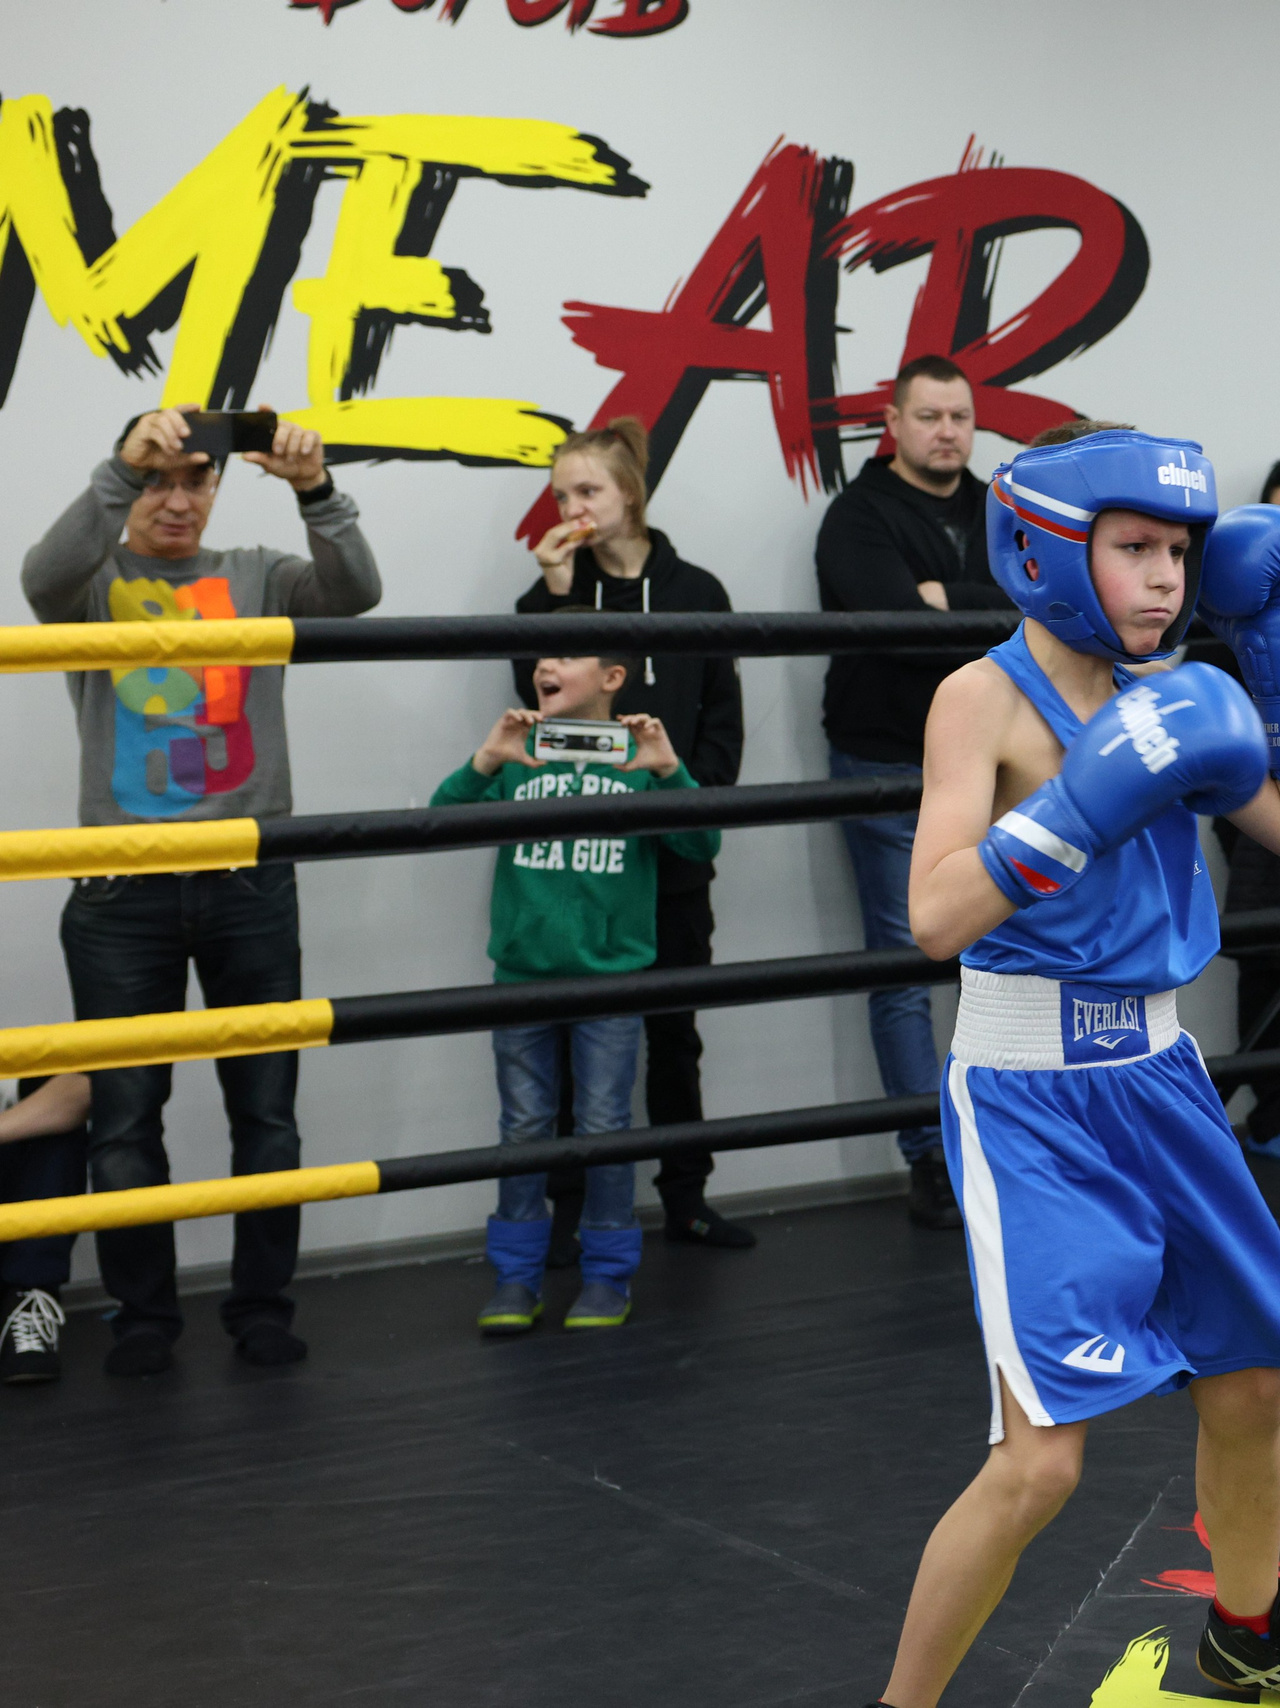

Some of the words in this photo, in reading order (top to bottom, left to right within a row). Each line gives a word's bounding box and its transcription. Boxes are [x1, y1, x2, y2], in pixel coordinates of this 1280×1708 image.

[1157, 461, 1207, 494] clinch
[1115, 685, 1181, 775] clinch
[1072, 996, 1142, 1042] EVERLAST
